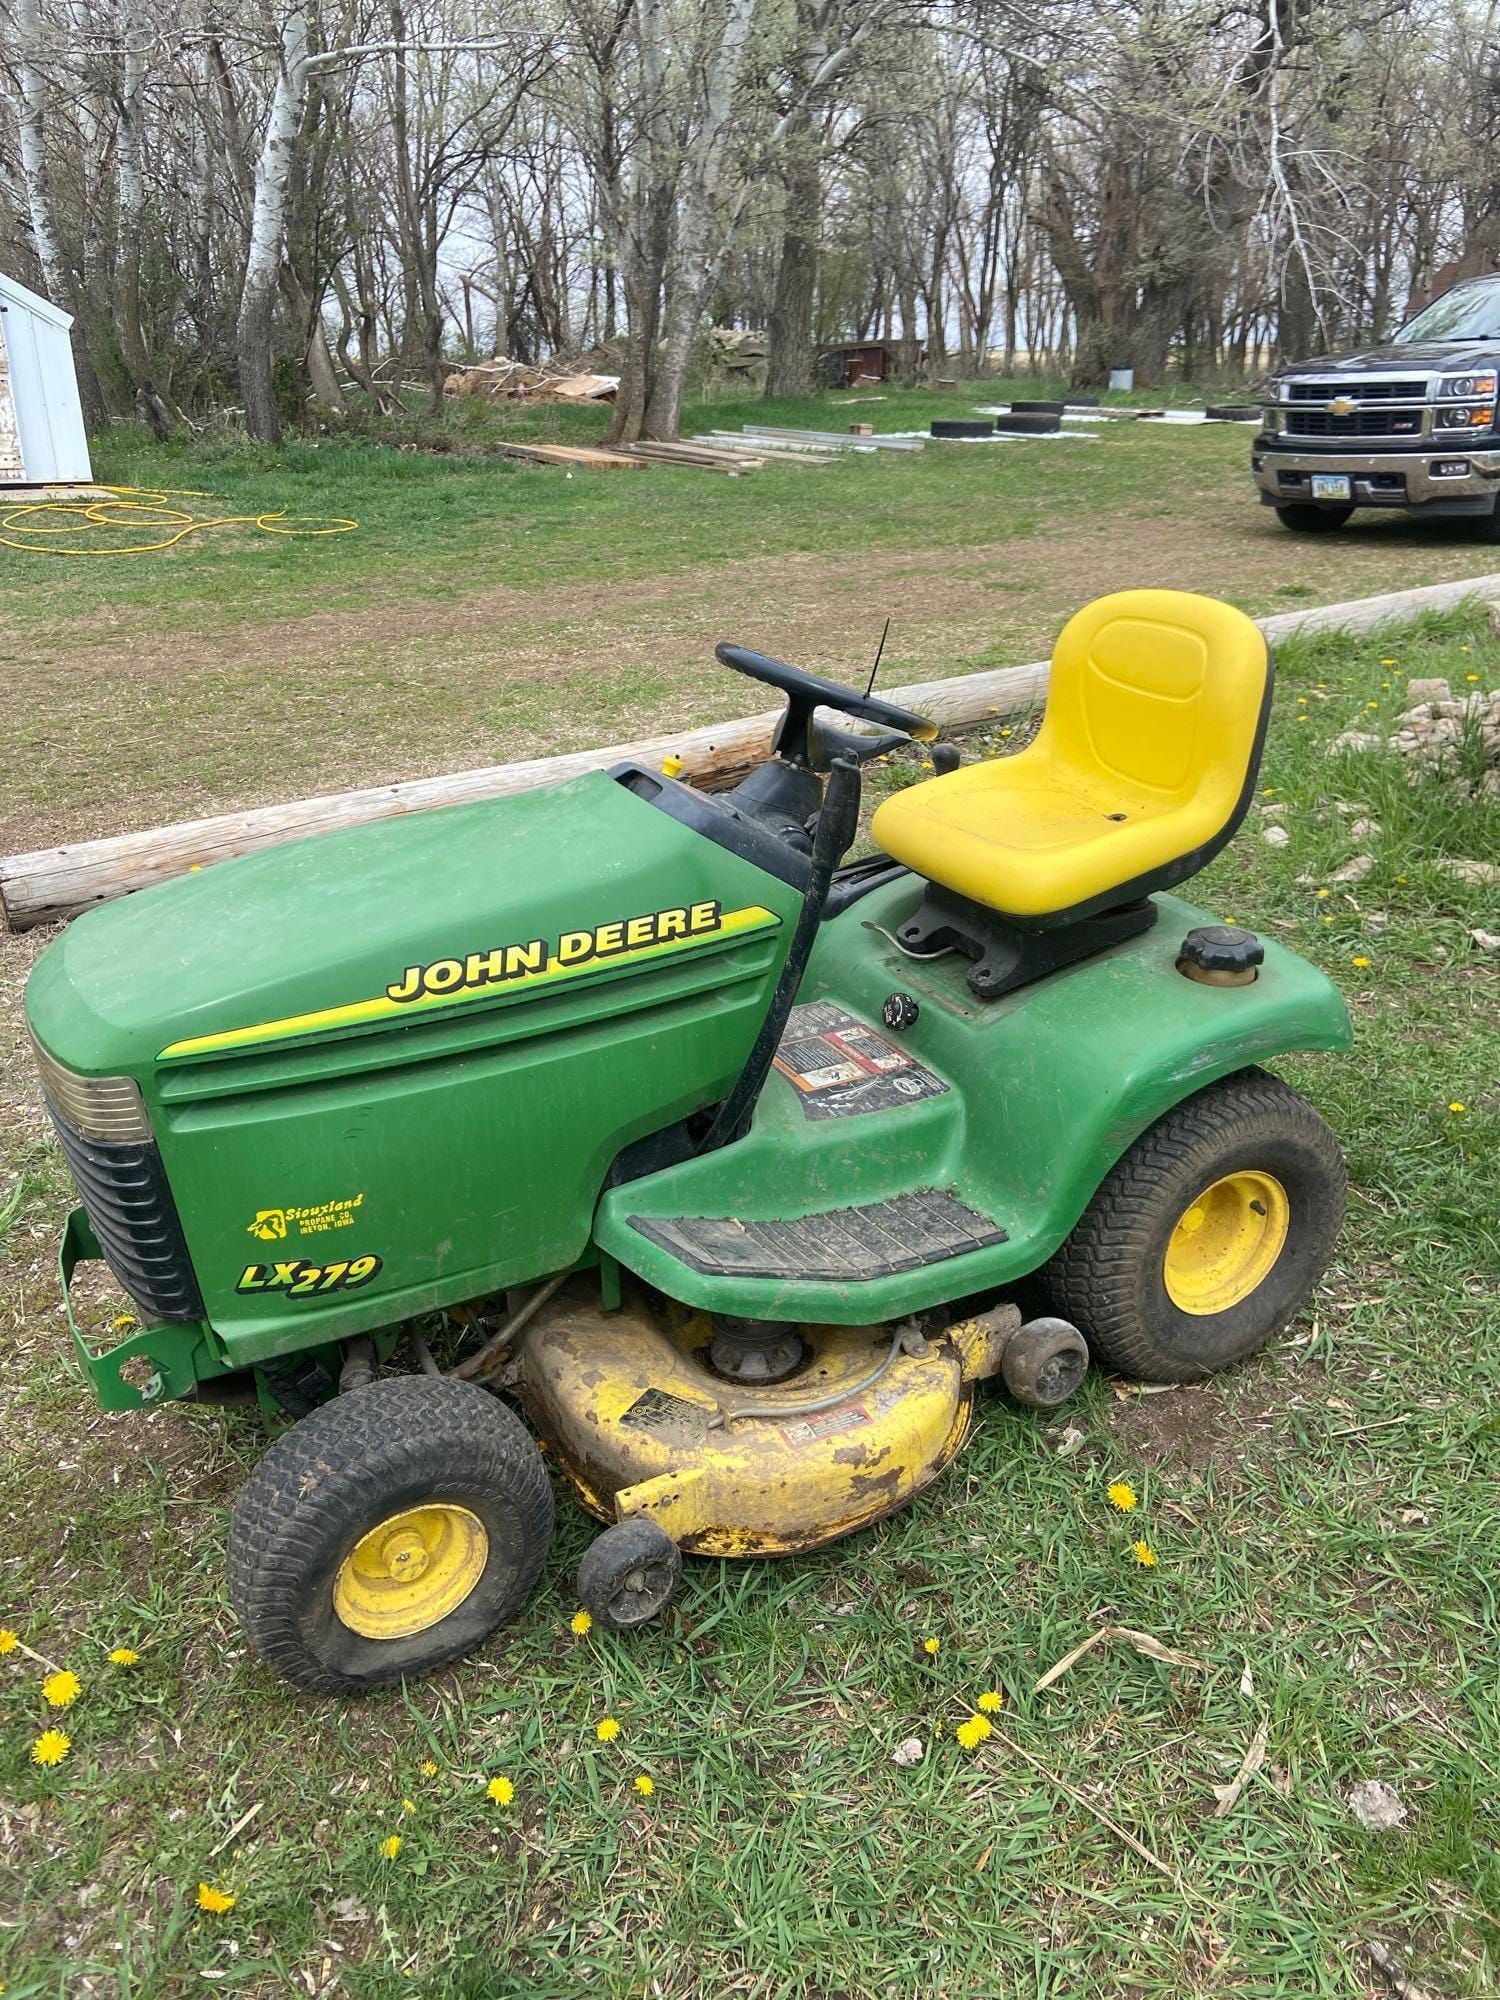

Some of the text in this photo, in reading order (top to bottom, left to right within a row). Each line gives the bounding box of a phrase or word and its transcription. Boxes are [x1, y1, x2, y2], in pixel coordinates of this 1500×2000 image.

[386, 900, 721, 1003] JOHN DEERE
[285, 1193, 363, 1221] Siouxland
[299, 1214, 336, 1226] PROPANE
[334, 1217, 355, 1228] IOWA
[235, 1254, 383, 1299] LX279
